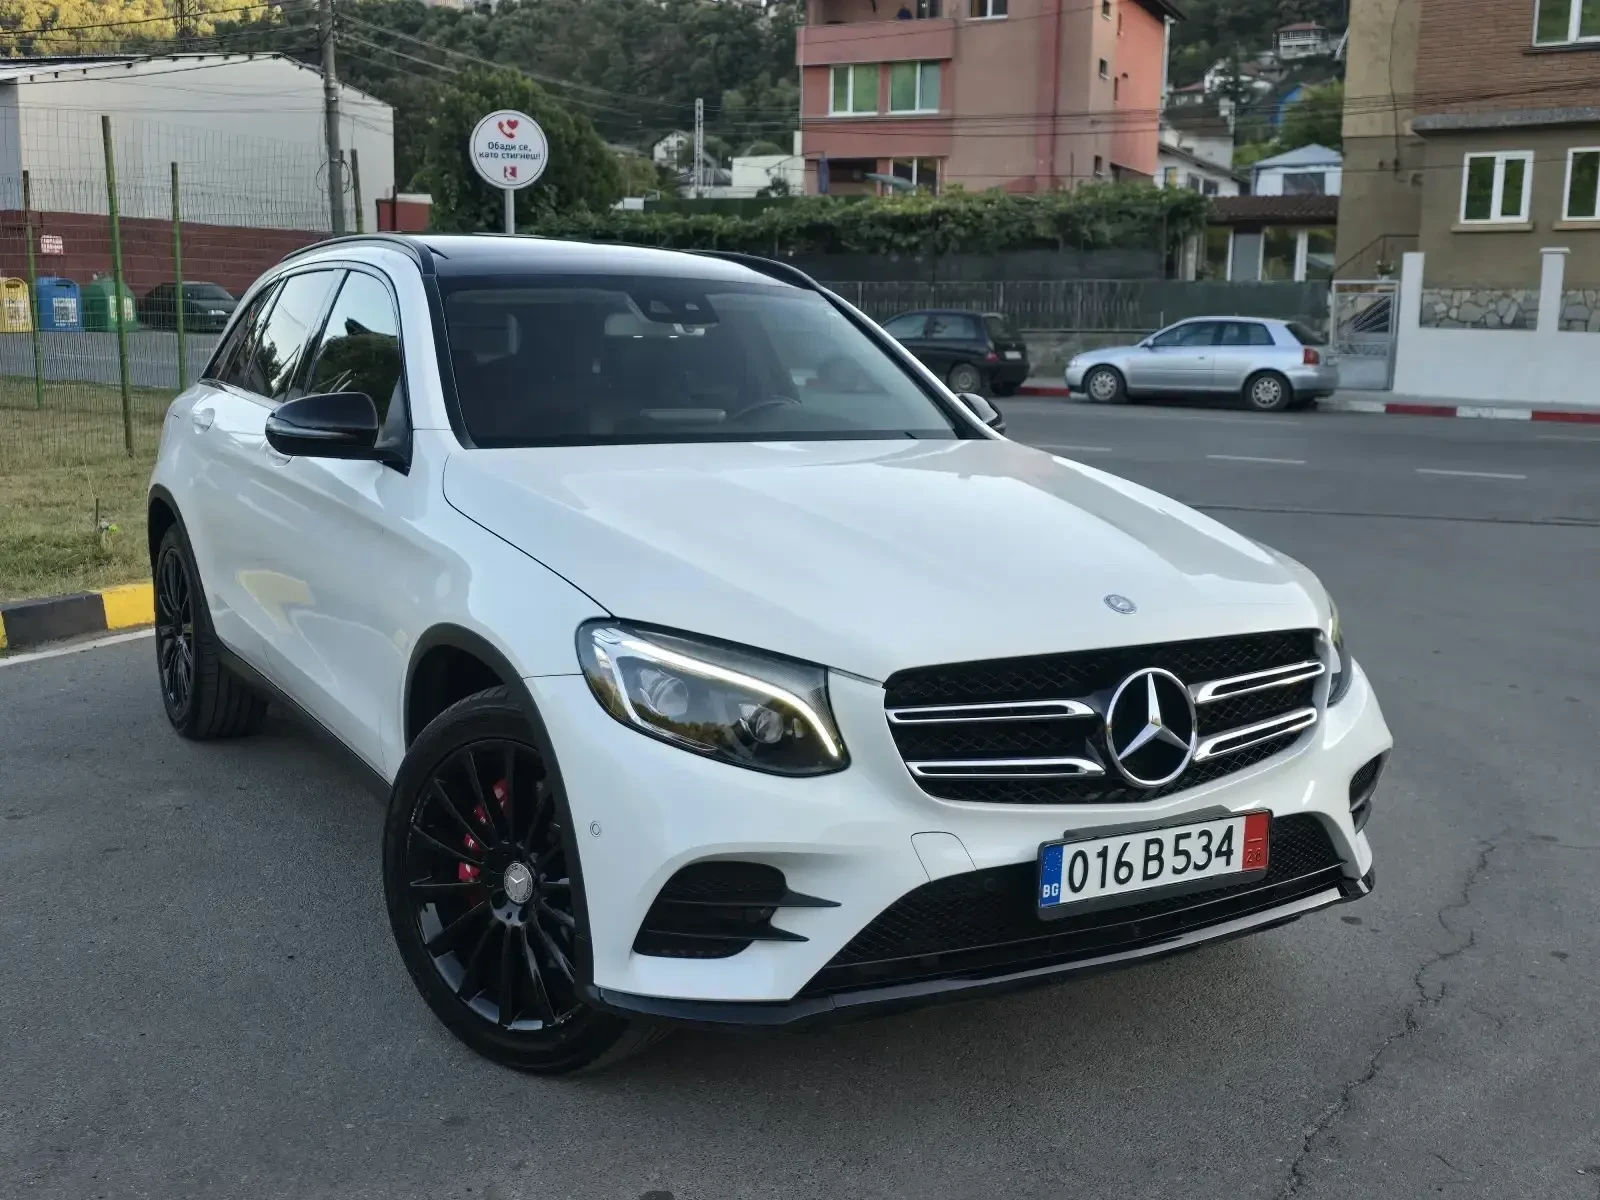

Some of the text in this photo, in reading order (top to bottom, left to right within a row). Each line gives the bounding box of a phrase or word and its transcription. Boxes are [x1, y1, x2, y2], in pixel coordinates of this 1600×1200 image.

[488, 142, 532, 152] Обади се,
[479, 151, 541, 160] като стигнеш!
[1043, 883, 1060, 899] BG
